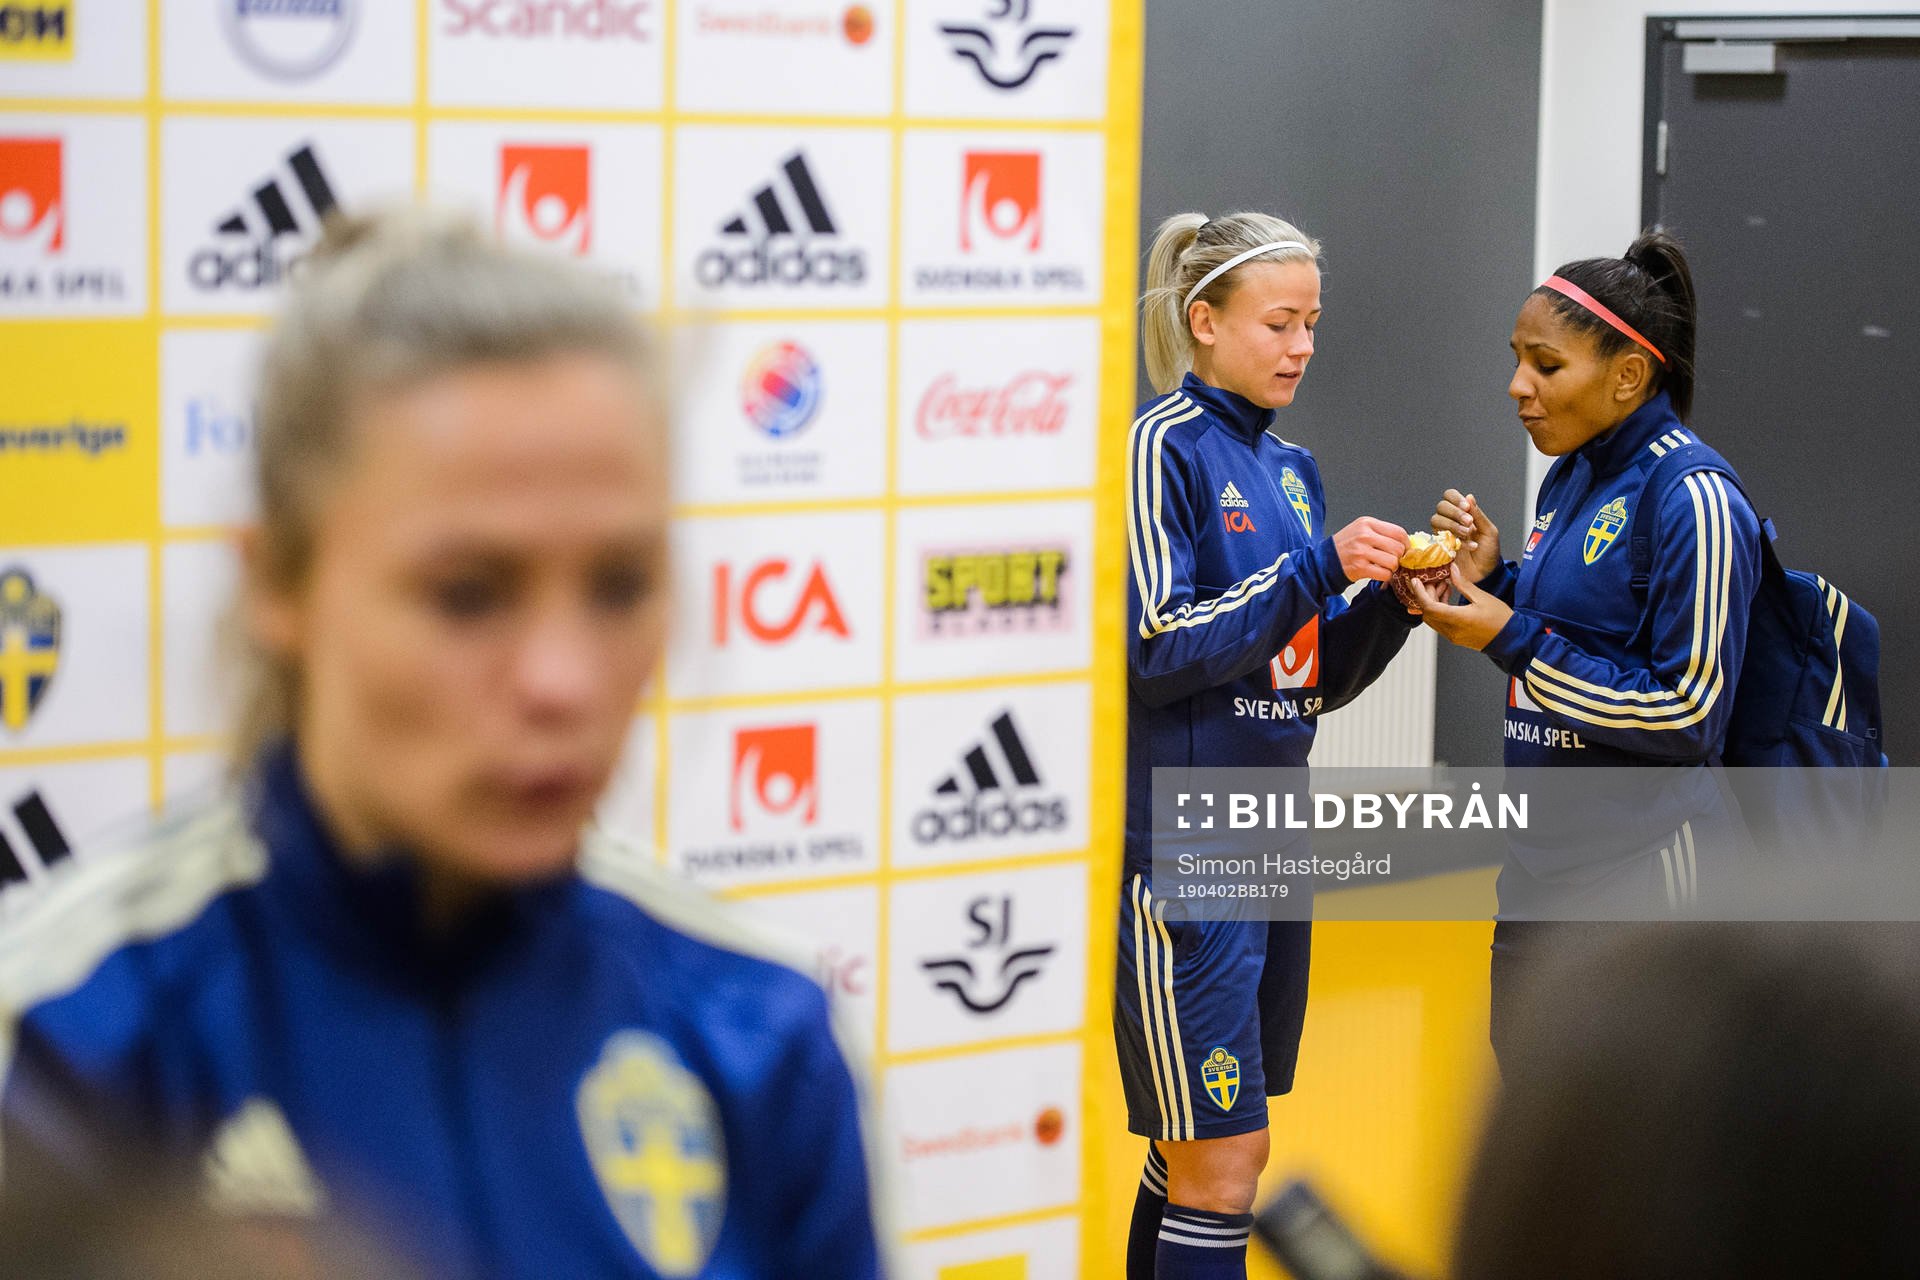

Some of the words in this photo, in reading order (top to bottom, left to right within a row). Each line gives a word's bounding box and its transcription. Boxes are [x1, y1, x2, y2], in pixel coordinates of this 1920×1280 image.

[696, 236, 867, 289] adidas
[913, 264, 1022, 291] SVENSKA
[1033, 264, 1085, 291] SPEL
[1220, 498, 1249, 508] adidas
[1223, 511, 1257, 533] ICA
[928, 552, 1067, 611] SPORT
[715, 559, 852, 648] ICA
[1543, 727, 1586, 749] SPEL
[913, 796, 1068, 845] adidas
[808, 838, 863, 862] SPEL
[966, 895, 1013, 948] SJ
[1208, 1064, 1234, 1073] SVERIGE
